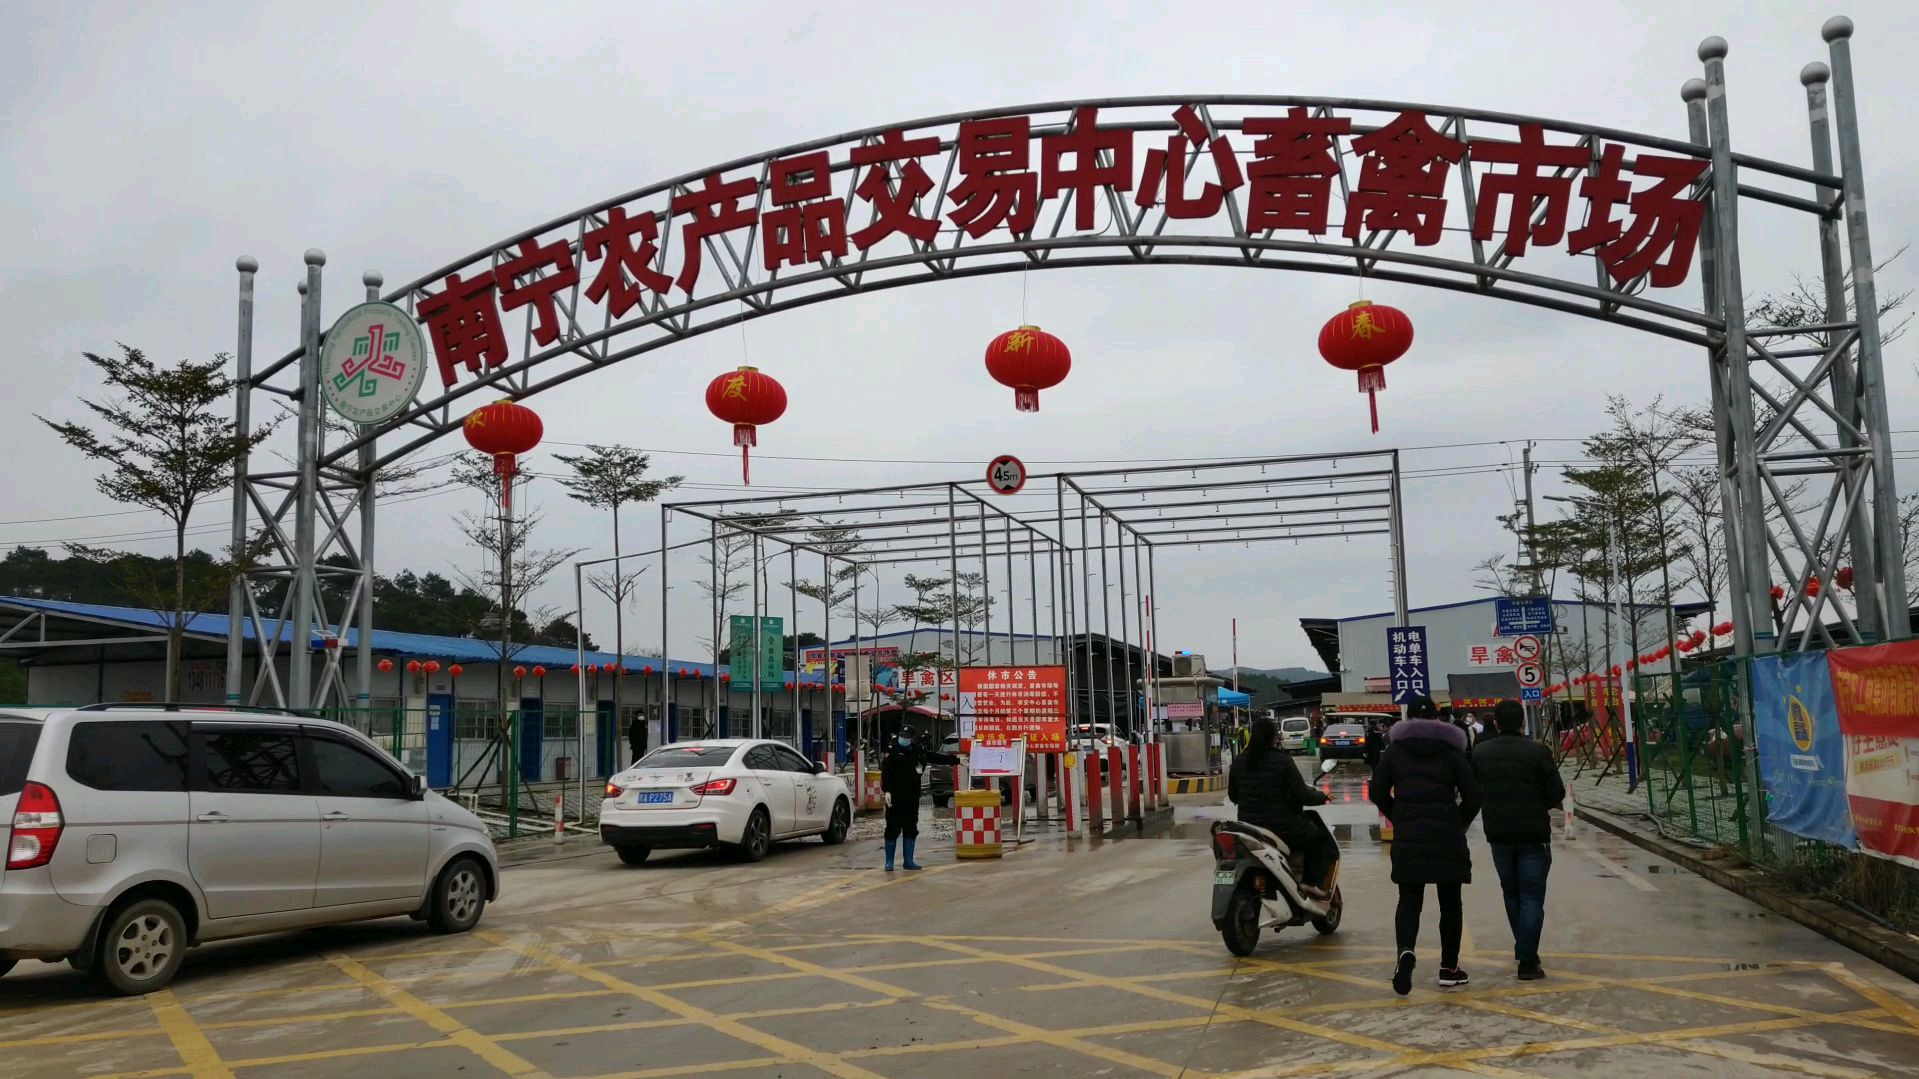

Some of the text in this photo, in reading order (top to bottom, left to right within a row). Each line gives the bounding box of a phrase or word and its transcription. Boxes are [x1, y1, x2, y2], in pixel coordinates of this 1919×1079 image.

[416, 103, 1711, 387] 南宁农产品交易中心畜禽市场
[1350, 310, 1386, 341] 春
[1004, 331, 1035, 355] 新
[1392, 631, 1408, 689] 机动车入口
[1408, 630, 1424, 689] 电单车入口
[987, 670, 1038, 680] 休市公告
[1524, 666, 1536, 682] 5
[1524, 690, 1540, 698] 入口
